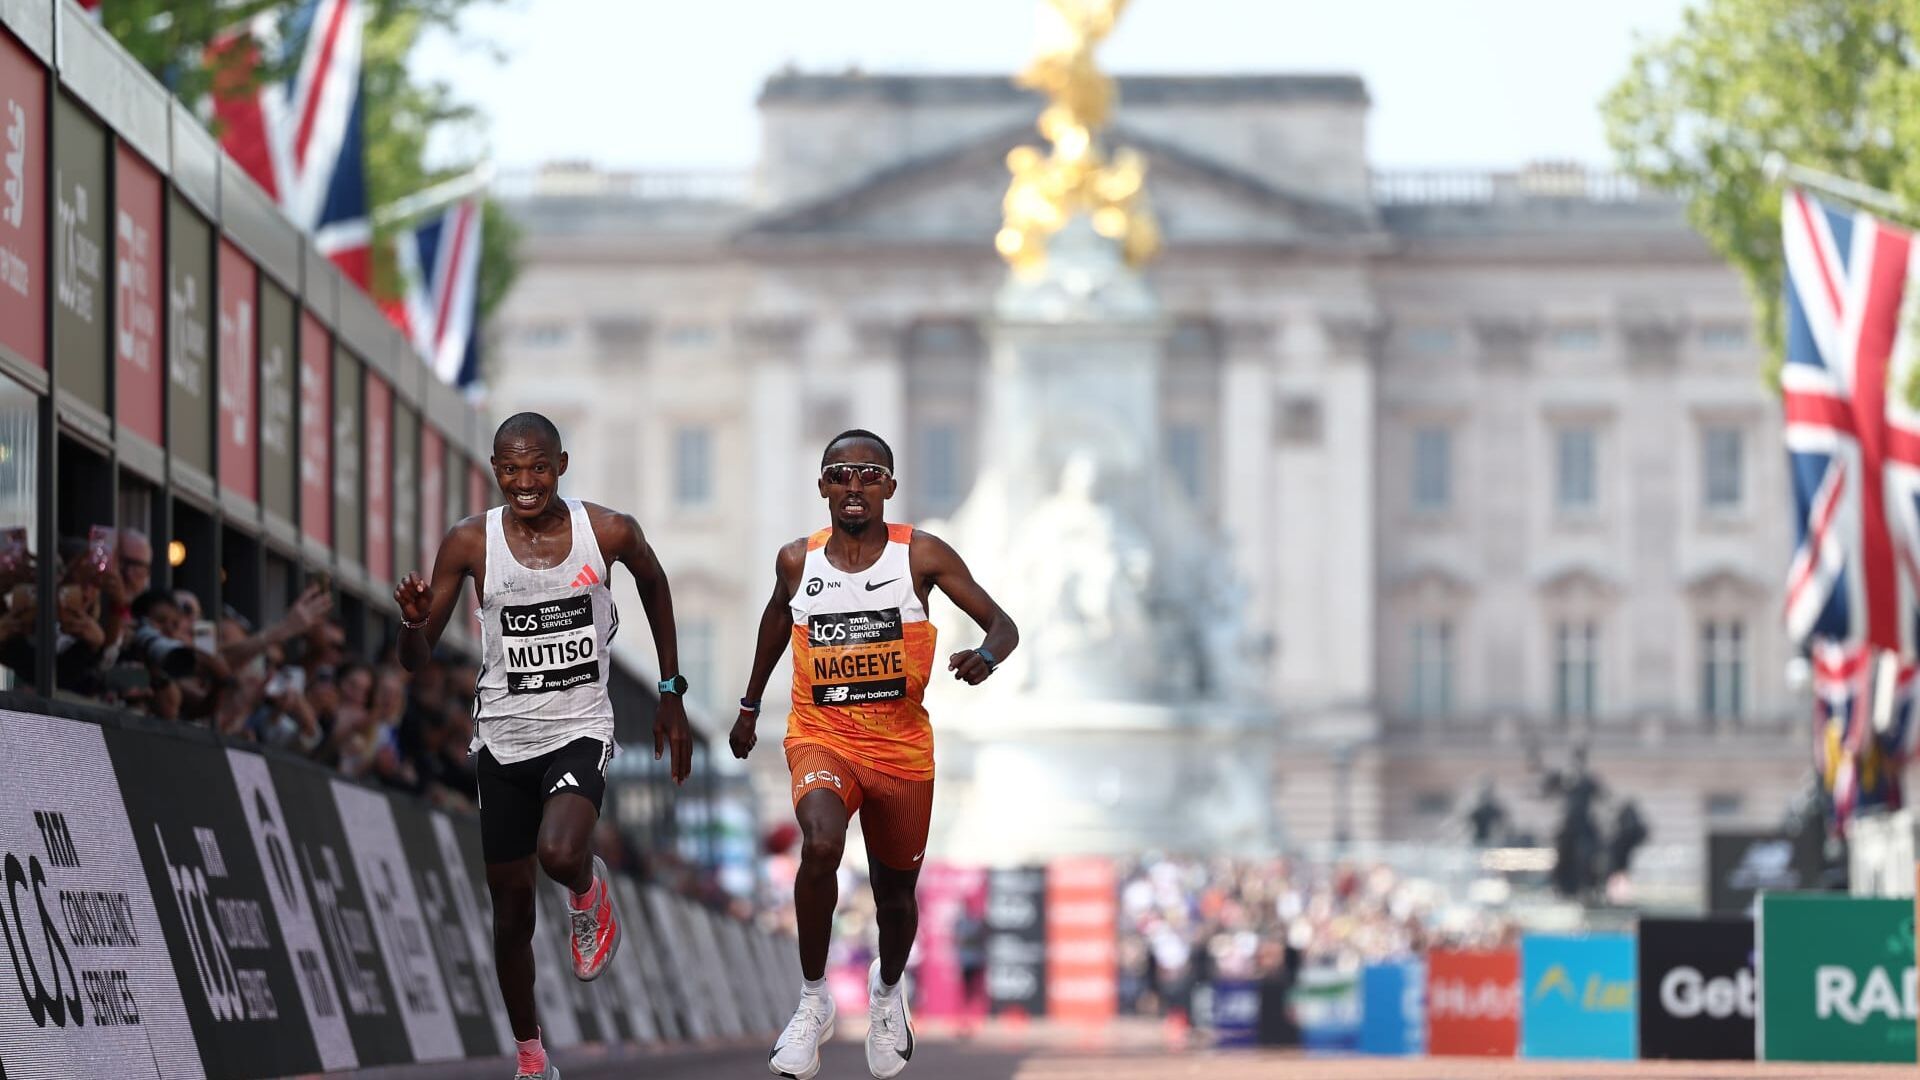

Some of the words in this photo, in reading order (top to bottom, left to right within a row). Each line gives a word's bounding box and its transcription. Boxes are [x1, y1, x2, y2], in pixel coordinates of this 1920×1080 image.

[505, 611, 538, 631] tcs
[540, 607, 586, 621] CONSULTANCY
[539, 605, 561, 614] TATA
[849, 616, 869, 624] TATA
[541, 618, 573, 628] SERVICES
[814, 620, 846, 641] tcs
[849, 621, 895, 631] CONSULTANCY
[849, 630, 880, 639] SERVICES
[508, 636, 594, 668] MUTISO
[814, 651, 902, 680] NAGEEYE
[545, 678, 562, 687] new
[562, 673, 591, 686] balance
[850, 693, 867, 701] new
[867, 689, 899, 699] balance
[33, 810, 81, 868] TATA
[60, 890, 141, 948] CONSULTANCY
[154, 823, 245, 1022] tcs
[82, 969, 140, 1027] SERVICES
